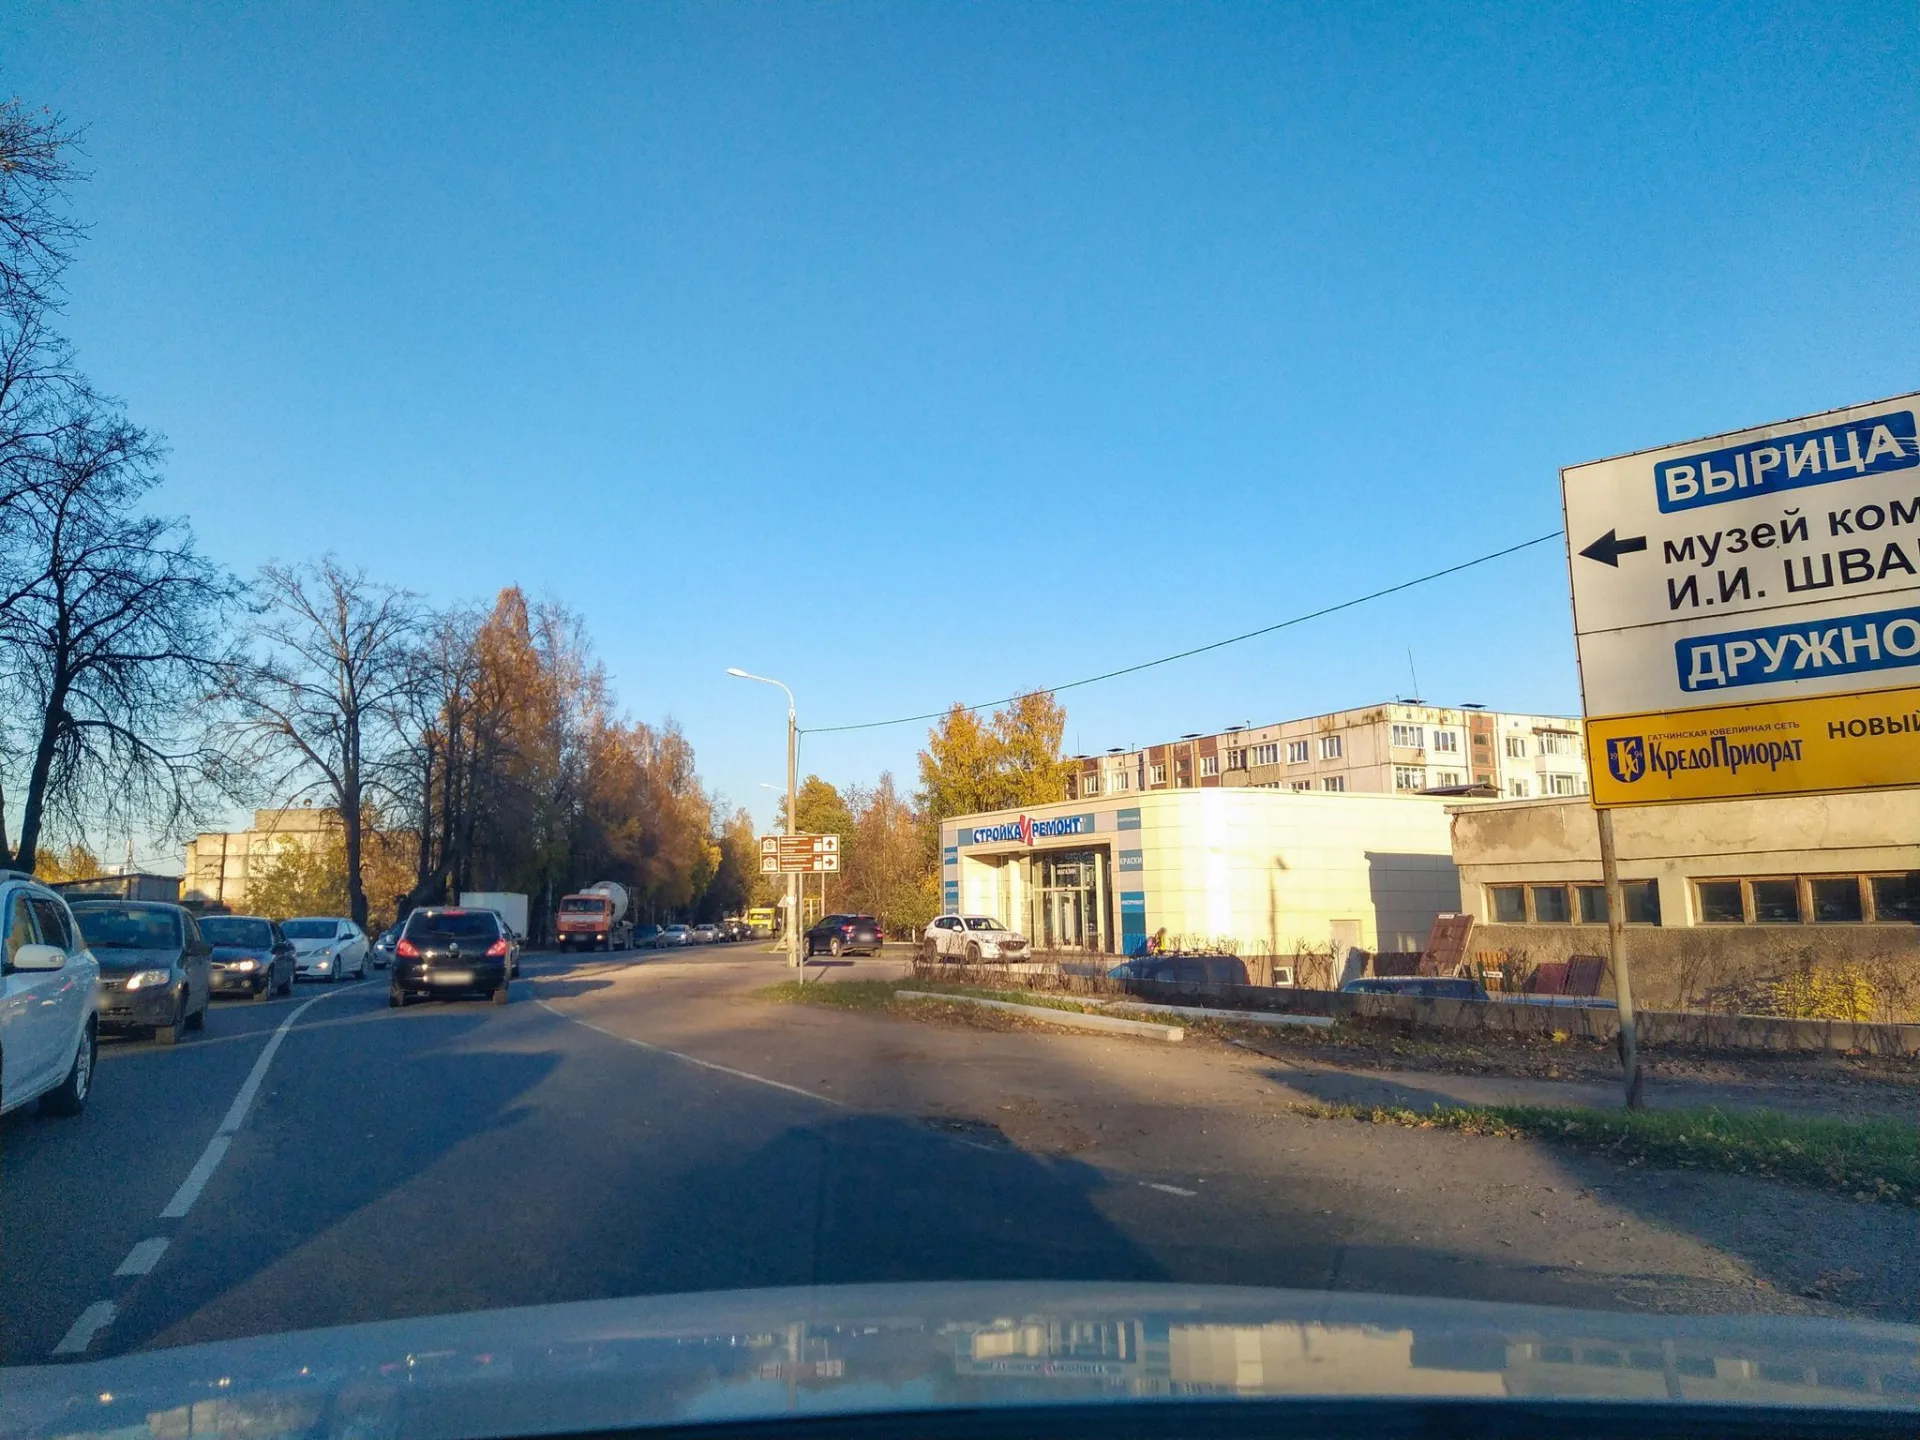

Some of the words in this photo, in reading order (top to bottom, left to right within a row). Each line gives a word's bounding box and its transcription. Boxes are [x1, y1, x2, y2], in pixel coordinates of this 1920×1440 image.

[1665, 424, 1906, 502] ВЫРИЦА
[1664, 507, 1809, 567] музей
[1667, 566, 1766, 611] И.И.
[1783, 538, 1920, 593] ШВА
[1688, 618, 1920, 689] ДРУЖНО
[1647, 729, 1708, 741] ГАТЧИНСКАЯ
[1709, 723, 1772, 736] ЮВЕЛИРНАЯ
[1774, 721, 1801, 731] СЕТЬ
[973, 823, 1022, 843] СТРОЙКА
[1032, 817, 1082, 838] РЕМОНТ
[1119, 856, 1142, 866] КРАСКИ
